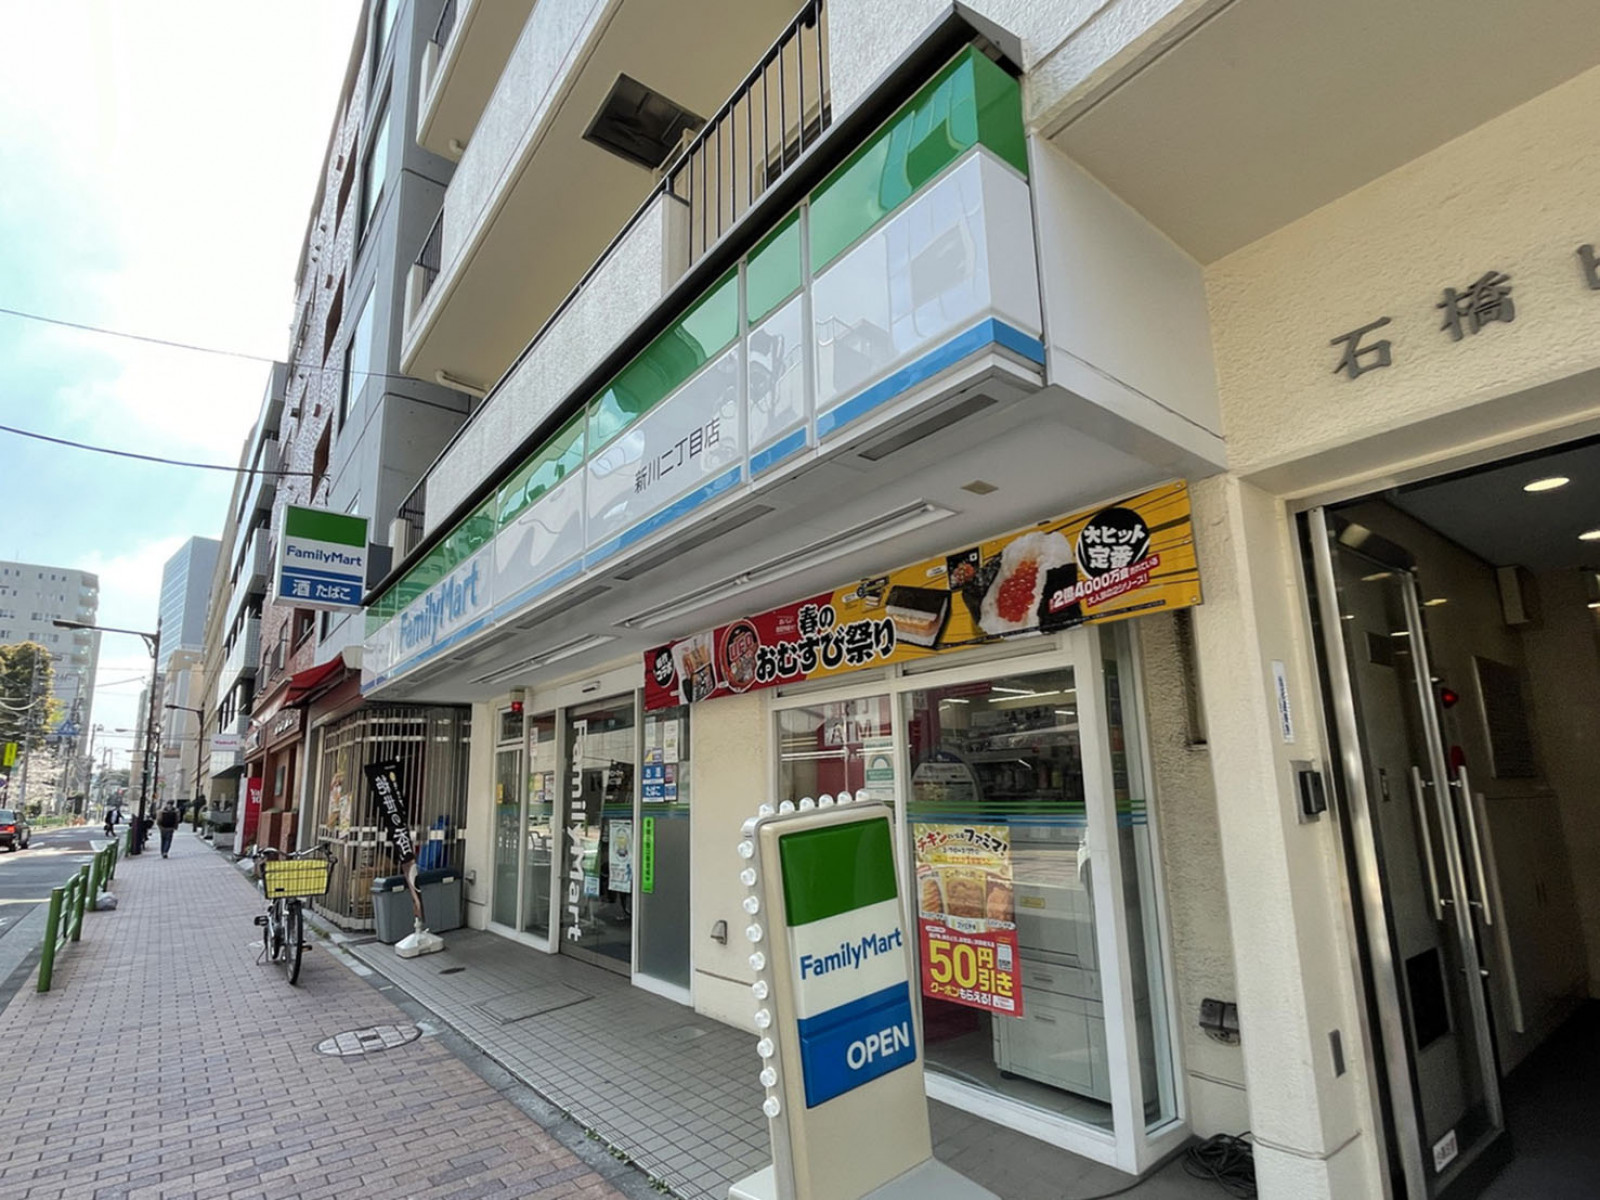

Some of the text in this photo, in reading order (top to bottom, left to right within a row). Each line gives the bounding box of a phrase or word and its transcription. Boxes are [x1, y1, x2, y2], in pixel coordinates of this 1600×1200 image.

[634, 417, 721, 495] 新川二丁目店
[287, 545, 362, 568] FamilyMart
[1083, 523, 1146, 545] 大ヒット
[1087, 545, 1135, 569] 定番
[292, 579, 351, 601] 酒 たばこ
[400, 562, 480, 652] FamilyMart
[799, 605, 836, 636] 春の
[756, 617, 896, 683] おむすび祭り
[567, 720, 588, 942] FamilyMart
[799, 927, 903, 981] FamilyMart
[846, 1021, 911, 1071] OPEN
